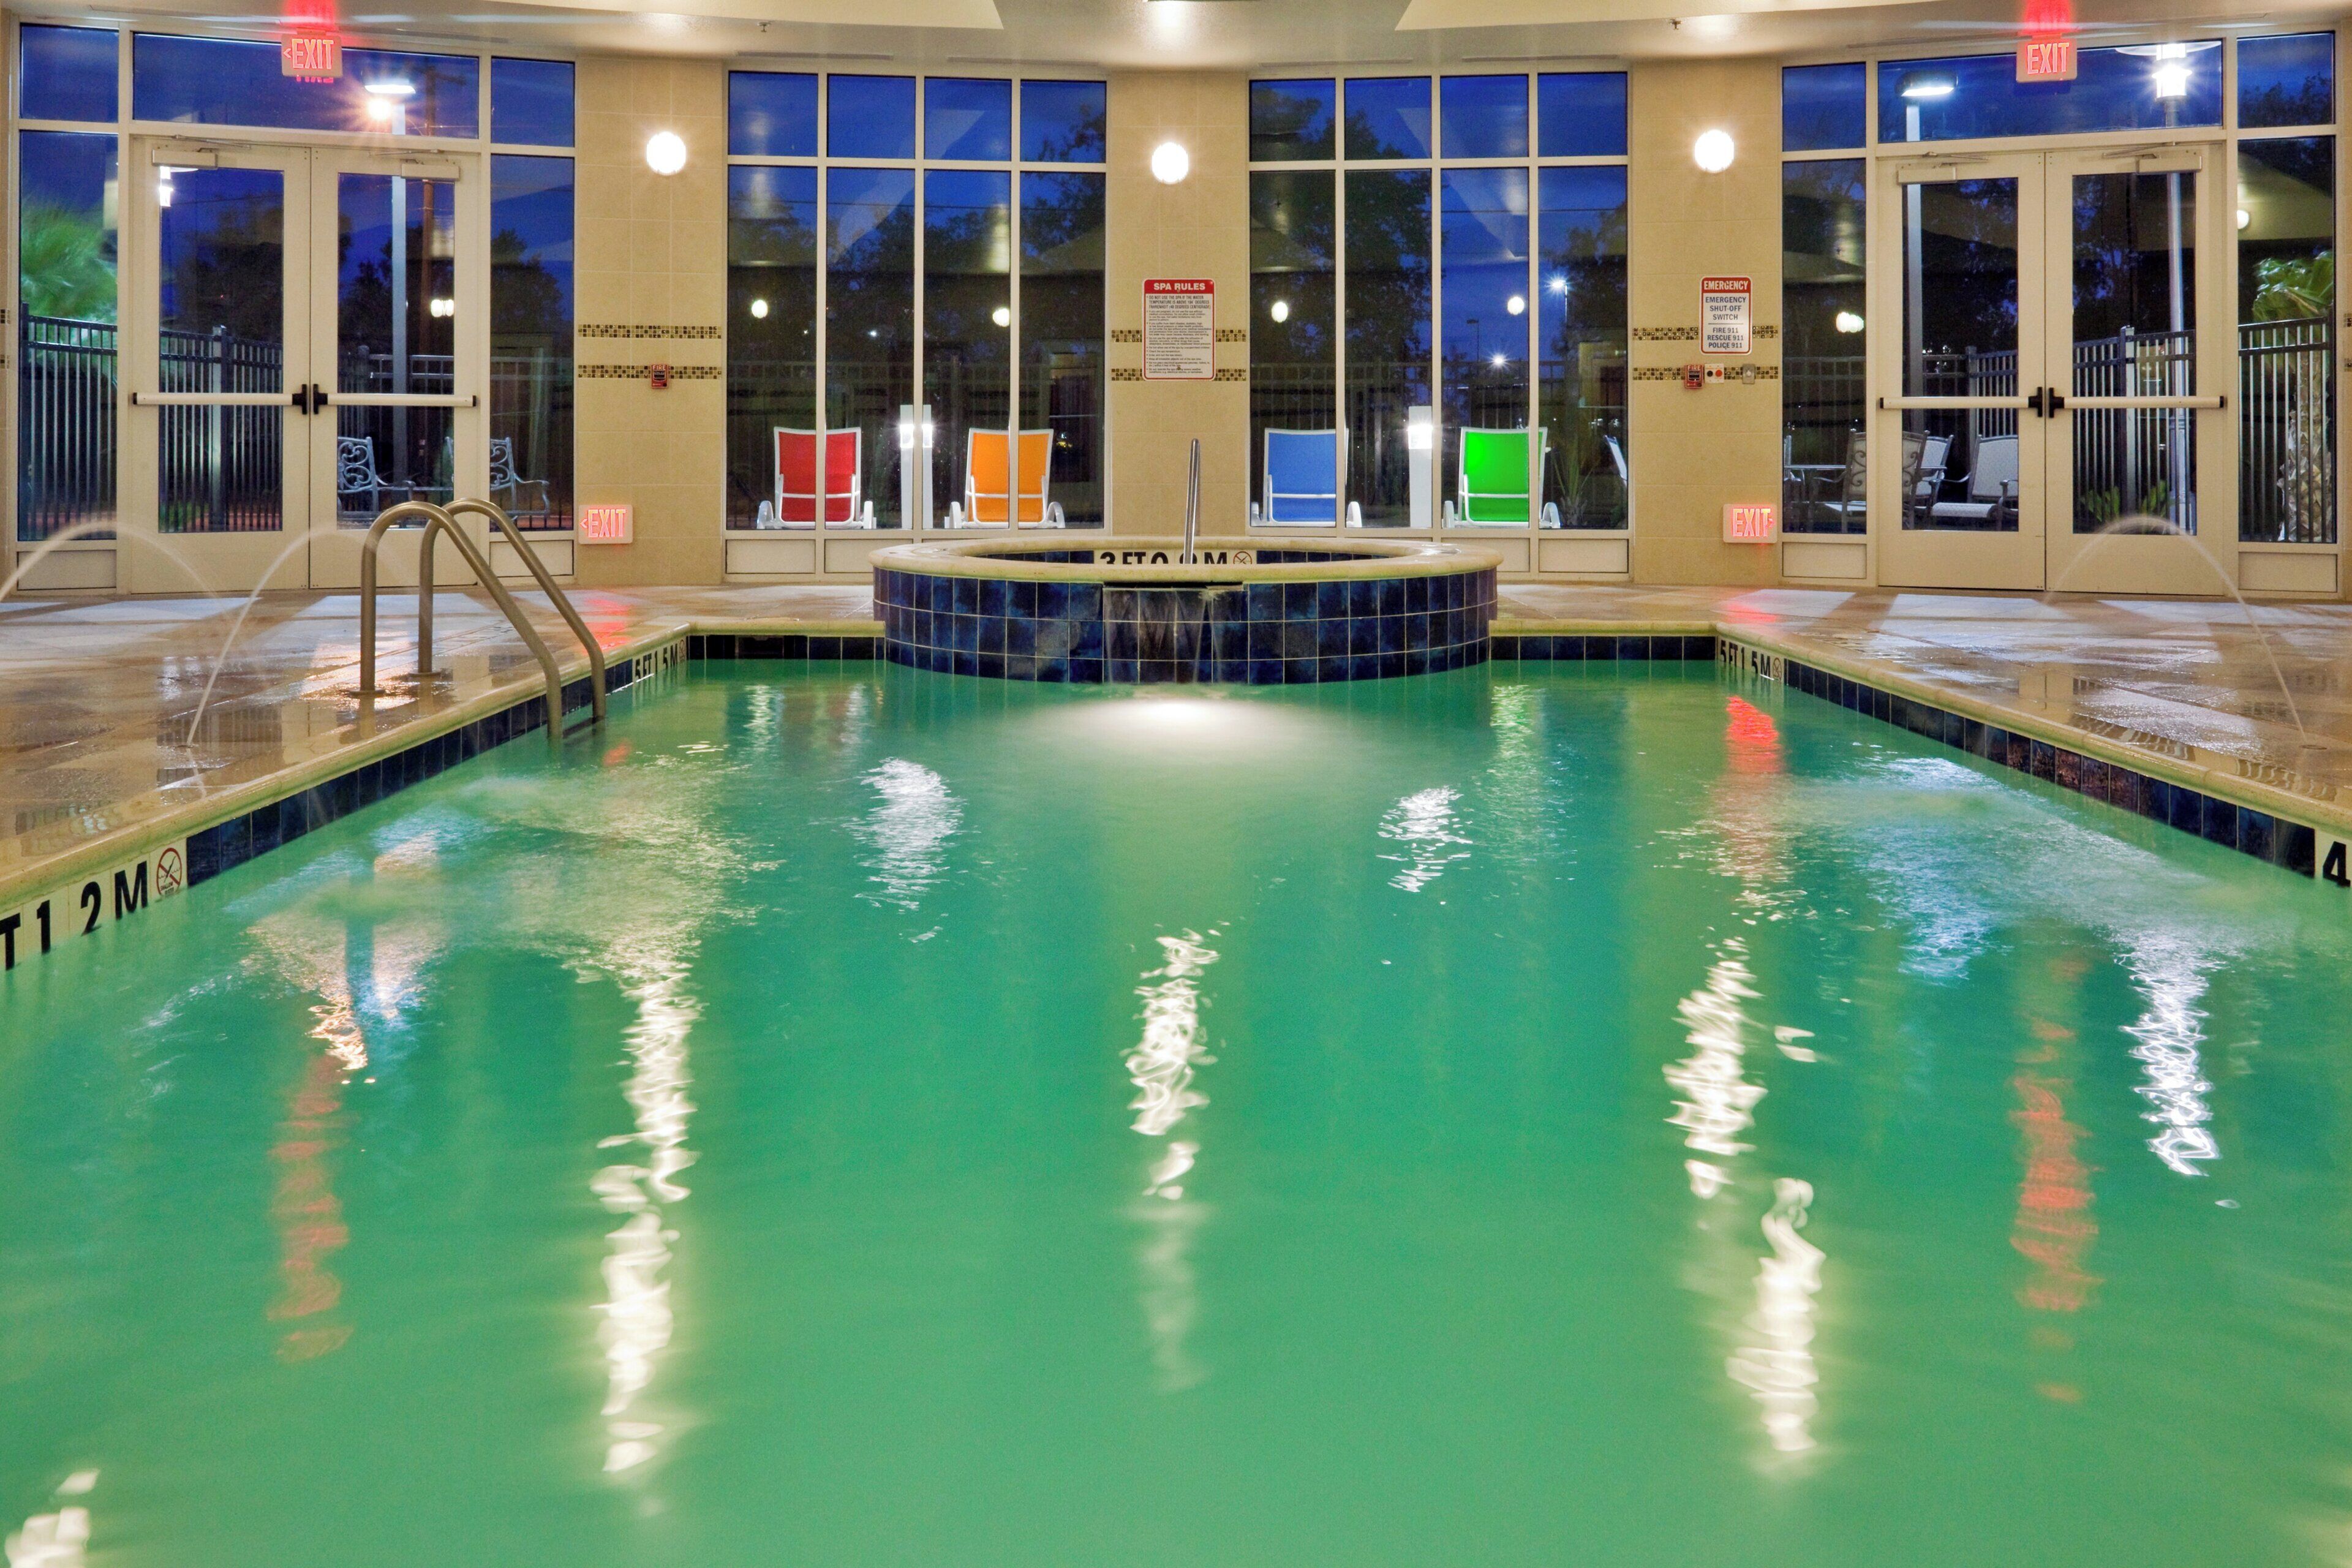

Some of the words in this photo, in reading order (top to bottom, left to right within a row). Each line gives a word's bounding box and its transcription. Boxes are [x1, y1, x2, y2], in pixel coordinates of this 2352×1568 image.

[292, 38, 334, 69] EXIT
[2027, 42, 2070, 74] EXIT
[1153, 282, 1172, 291] SPA
[1174, 282, 1206, 291] RULES
[1704, 281, 1748, 290] EMERGENCY
[587, 509, 626, 538] EXIT
[1732, 508, 1771, 537] EXIT
[2322, 840, 2351, 888] 4
[0, 913, 21, 971] T
